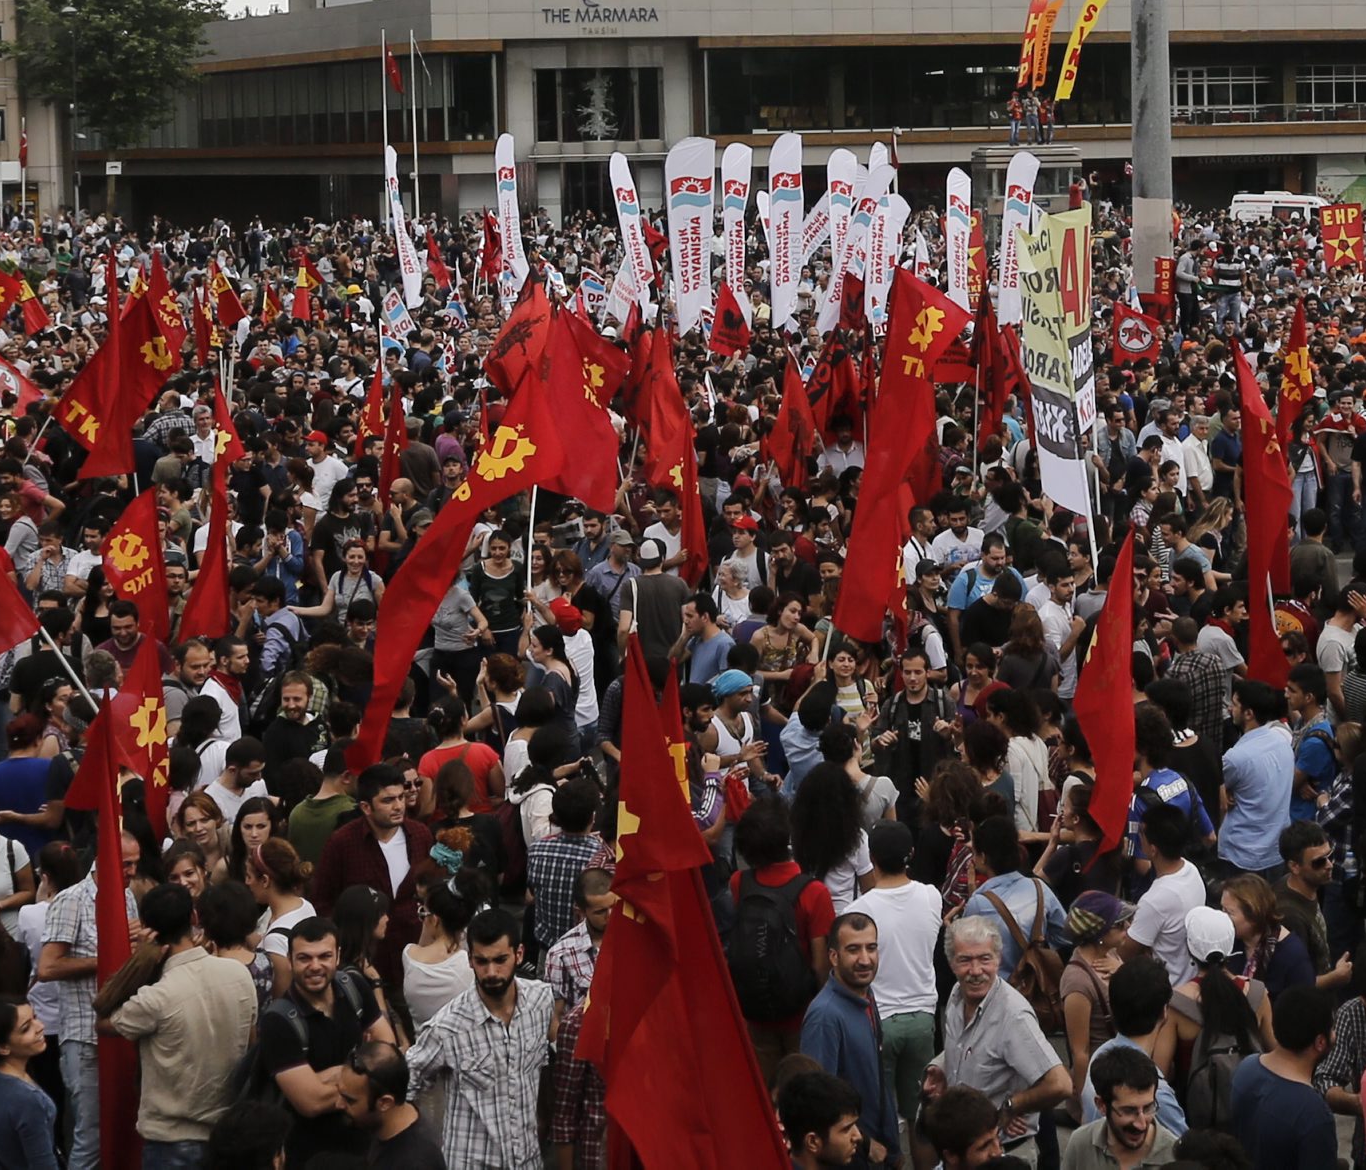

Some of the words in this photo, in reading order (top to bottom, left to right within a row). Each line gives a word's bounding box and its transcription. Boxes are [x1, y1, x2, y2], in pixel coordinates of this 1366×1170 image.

[541, 8, 571, 23] THE
[575, 7, 659, 23] MARMARA
[1197, 156, 1255, 165] STARUCKS
[1322, 207, 1359, 226] EHP
[158, 308, 181, 328] TKP
[65, 399, 101, 444] TK
